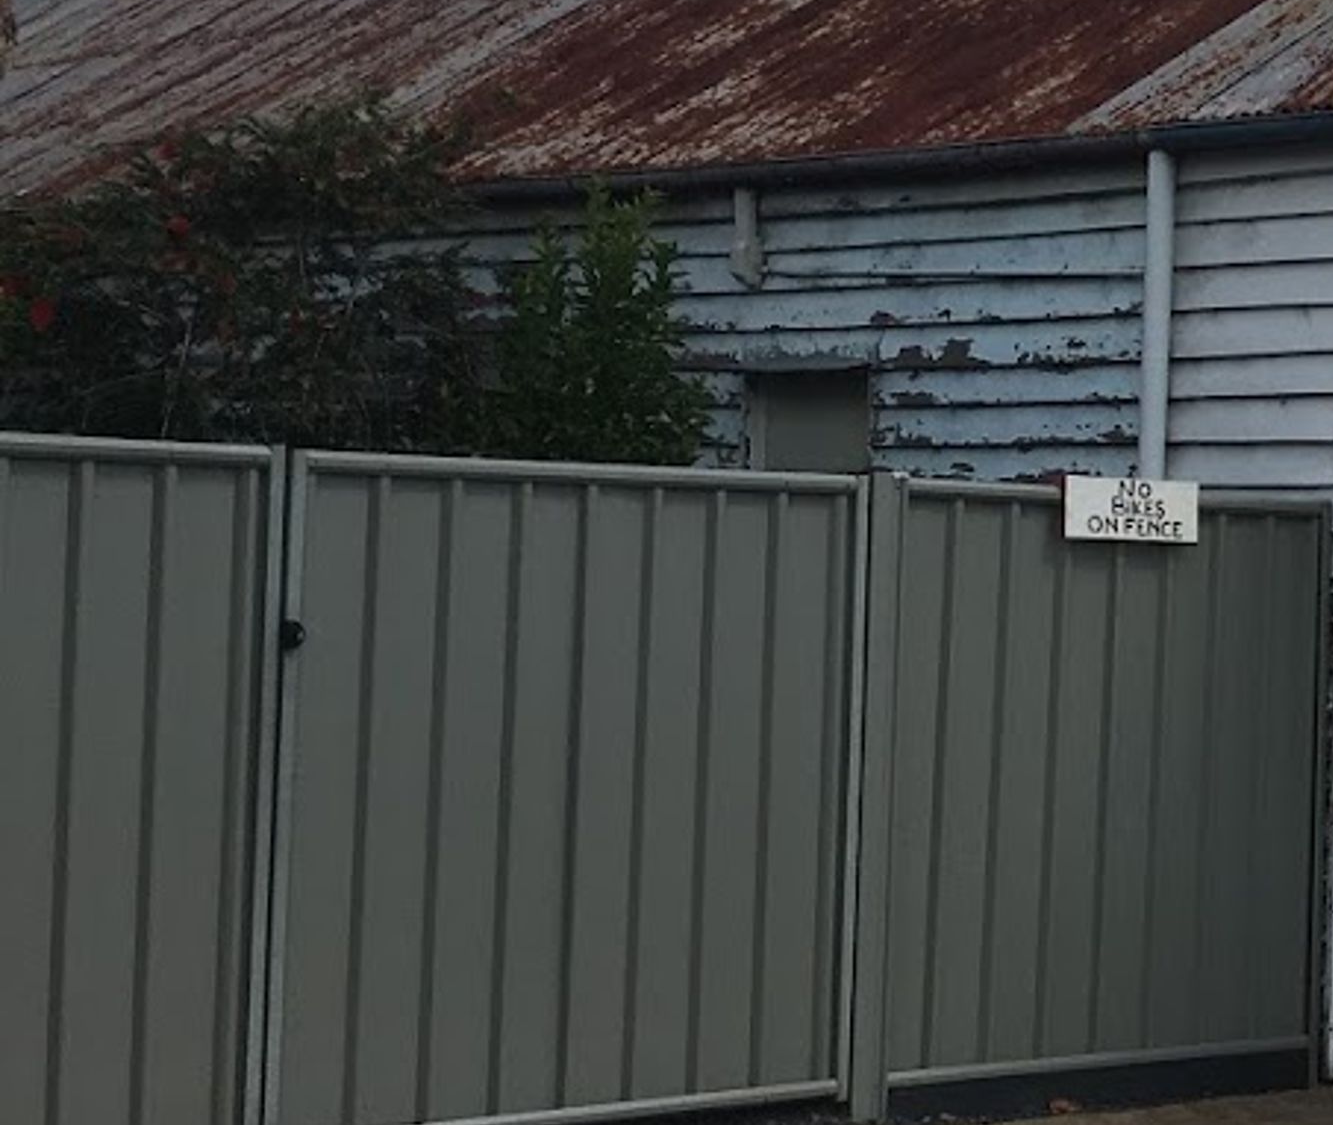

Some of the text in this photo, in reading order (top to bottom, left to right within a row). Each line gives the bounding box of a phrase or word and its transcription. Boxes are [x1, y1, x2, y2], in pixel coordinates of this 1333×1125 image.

[1119, 479, 1151, 499] NO
[1111, 495, 1166, 520] BIKES
[1087, 515, 1183, 539] ON FENCE
